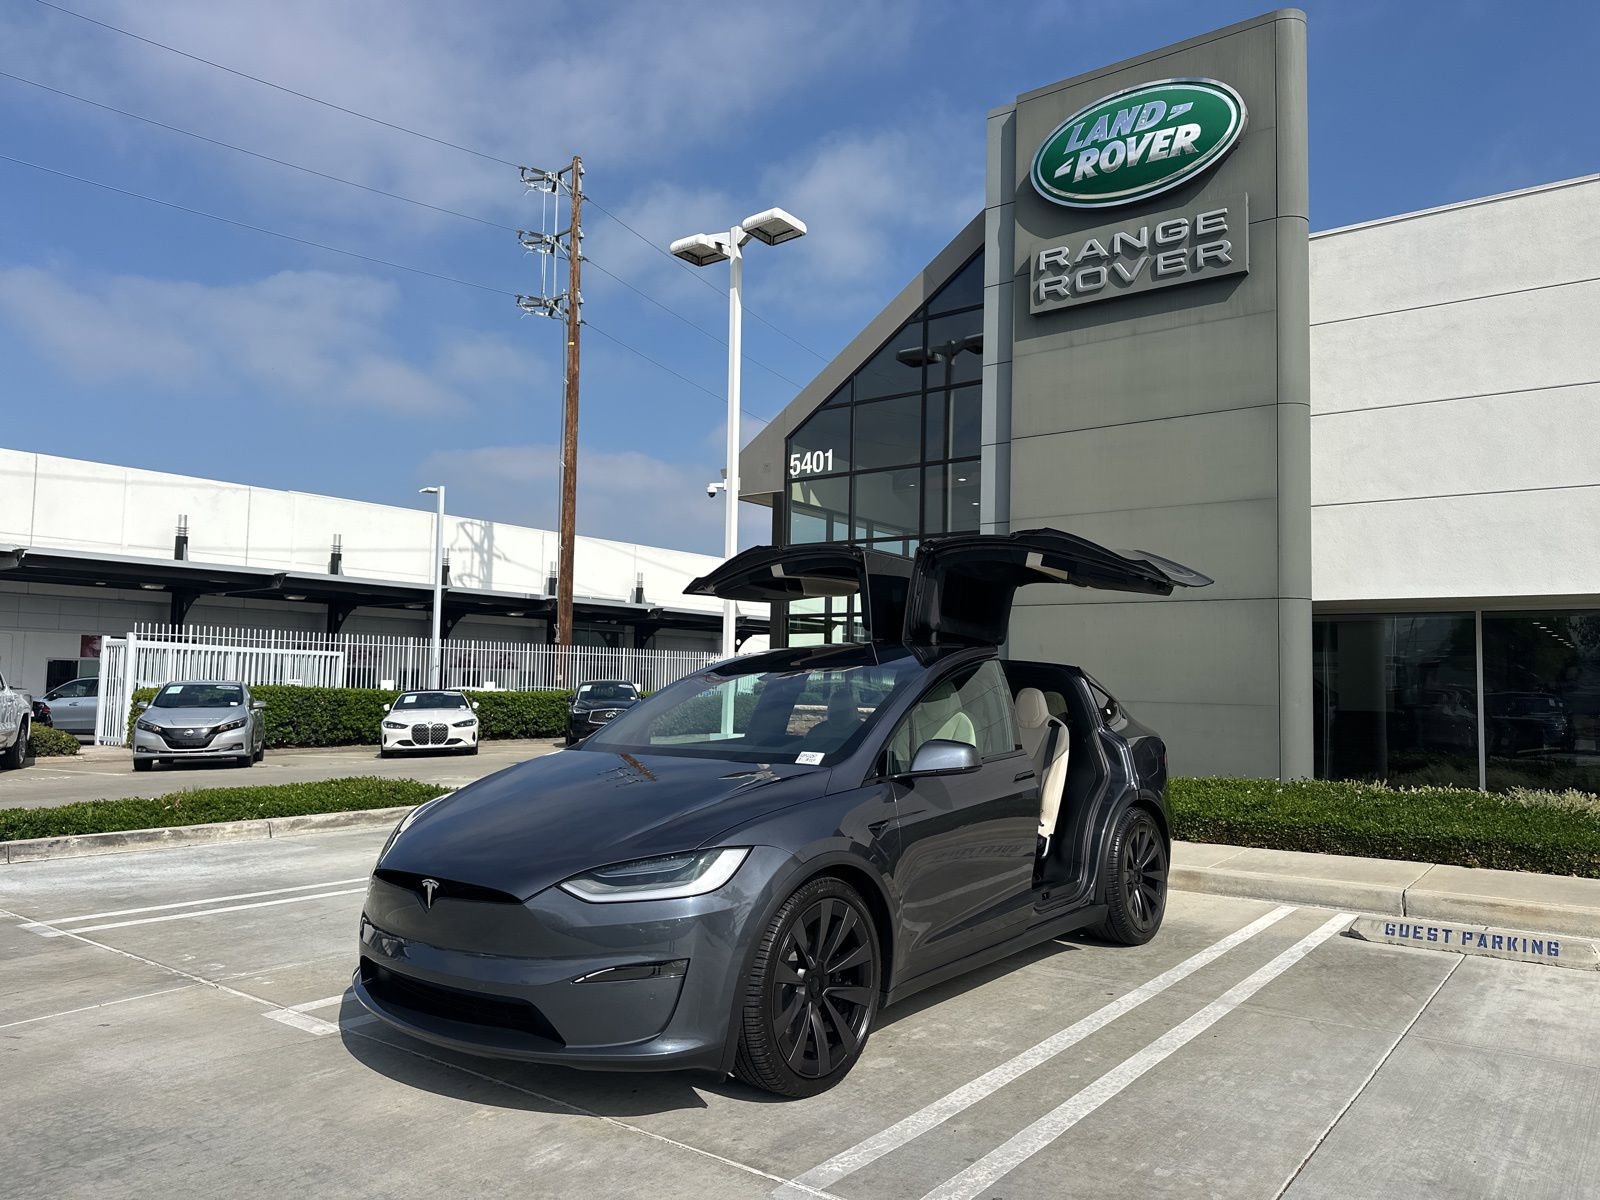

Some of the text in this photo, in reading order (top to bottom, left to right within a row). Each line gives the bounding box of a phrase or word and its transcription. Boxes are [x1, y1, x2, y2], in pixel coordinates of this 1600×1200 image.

[1063, 100, 1167, 155] LAND
[1072, 123, 1202, 183] ROVER
[1038, 207, 1228, 271] RANGE
[1038, 239, 1233, 301] ROVER
[789, 448, 833, 476] 5401
[1384, 922, 1560, 957] GUEST PARKING
